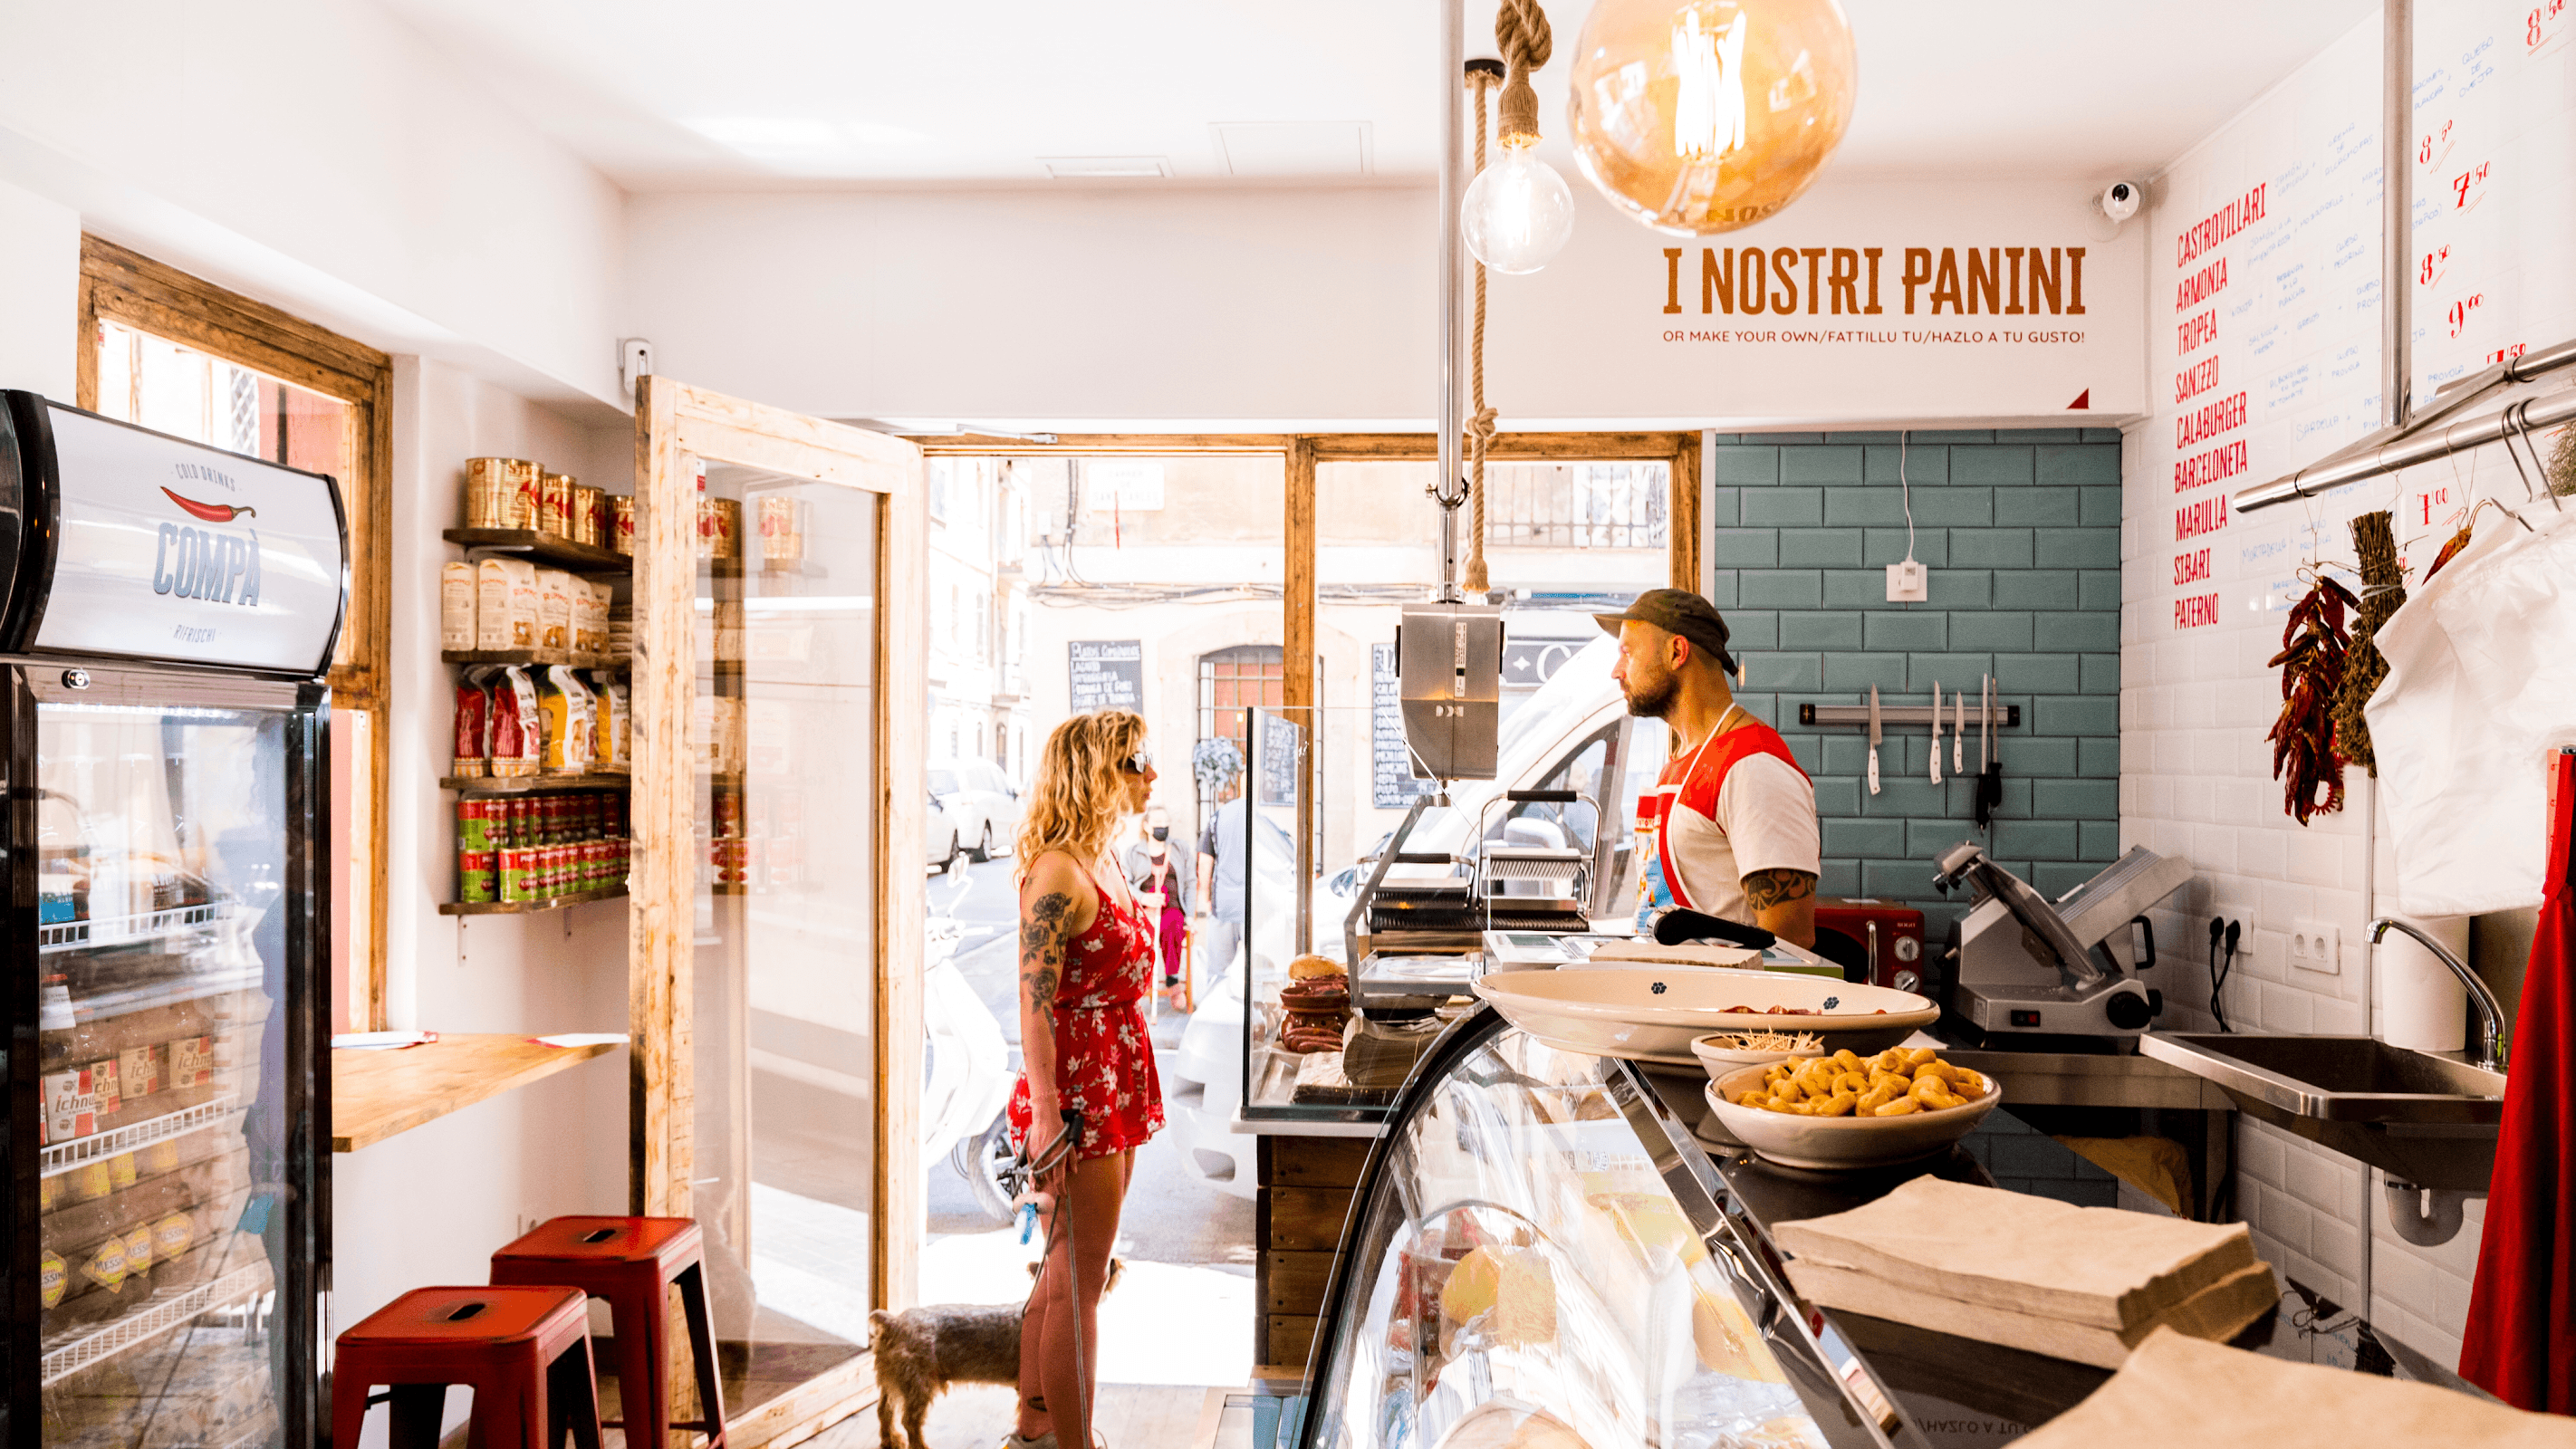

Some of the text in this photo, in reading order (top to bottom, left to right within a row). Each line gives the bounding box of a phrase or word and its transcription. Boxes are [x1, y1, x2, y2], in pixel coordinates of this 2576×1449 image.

[2462, 36, 2494, 65] QUESO
[2471, 60, 2483, 75] DE
[2459, 66, 2494, 98] OVEJA
[2453, 160, 2491, 211] 7'50
[2177, 181, 2266, 268] CASTROVILLARI
[1663, 246, 2087, 315] I NOSTRI PANINI
[2420, 244, 2451, 285] 8'50
[2176, 256, 2227, 314] ARMONIA
[2356, 278, 2380, 295] QUESO
[2177, 308, 2217, 356] TROPEA
[2449, 293, 2484, 339] 9'00
[1663, 330, 2085, 344] OR MAKE YOUR OWN/FATTILLU TU/HAZLO A TU GUSTO!
[2175, 354, 2218, 405] SANIZZO
[2427, 365, 2464, 384] PROVOLA
[2177, 390, 2246, 450] CALABURGER
[2296, 416, 2340, 442] SARDELLA
[175, 463, 235, 492] COLD DRINKS
[2174, 439, 2248, 494] BARCELONETA
[2176, 494, 2227, 542] MARULLA
[2417, 487, 2448, 526] 7'00
[152, 522, 262, 607] COMPÀ
[2174, 547, 2211, 586] SIBARI
[2175, 592, 2219, 630] PATERNO
[173, 623, 216, 643] RIFRISCHI
